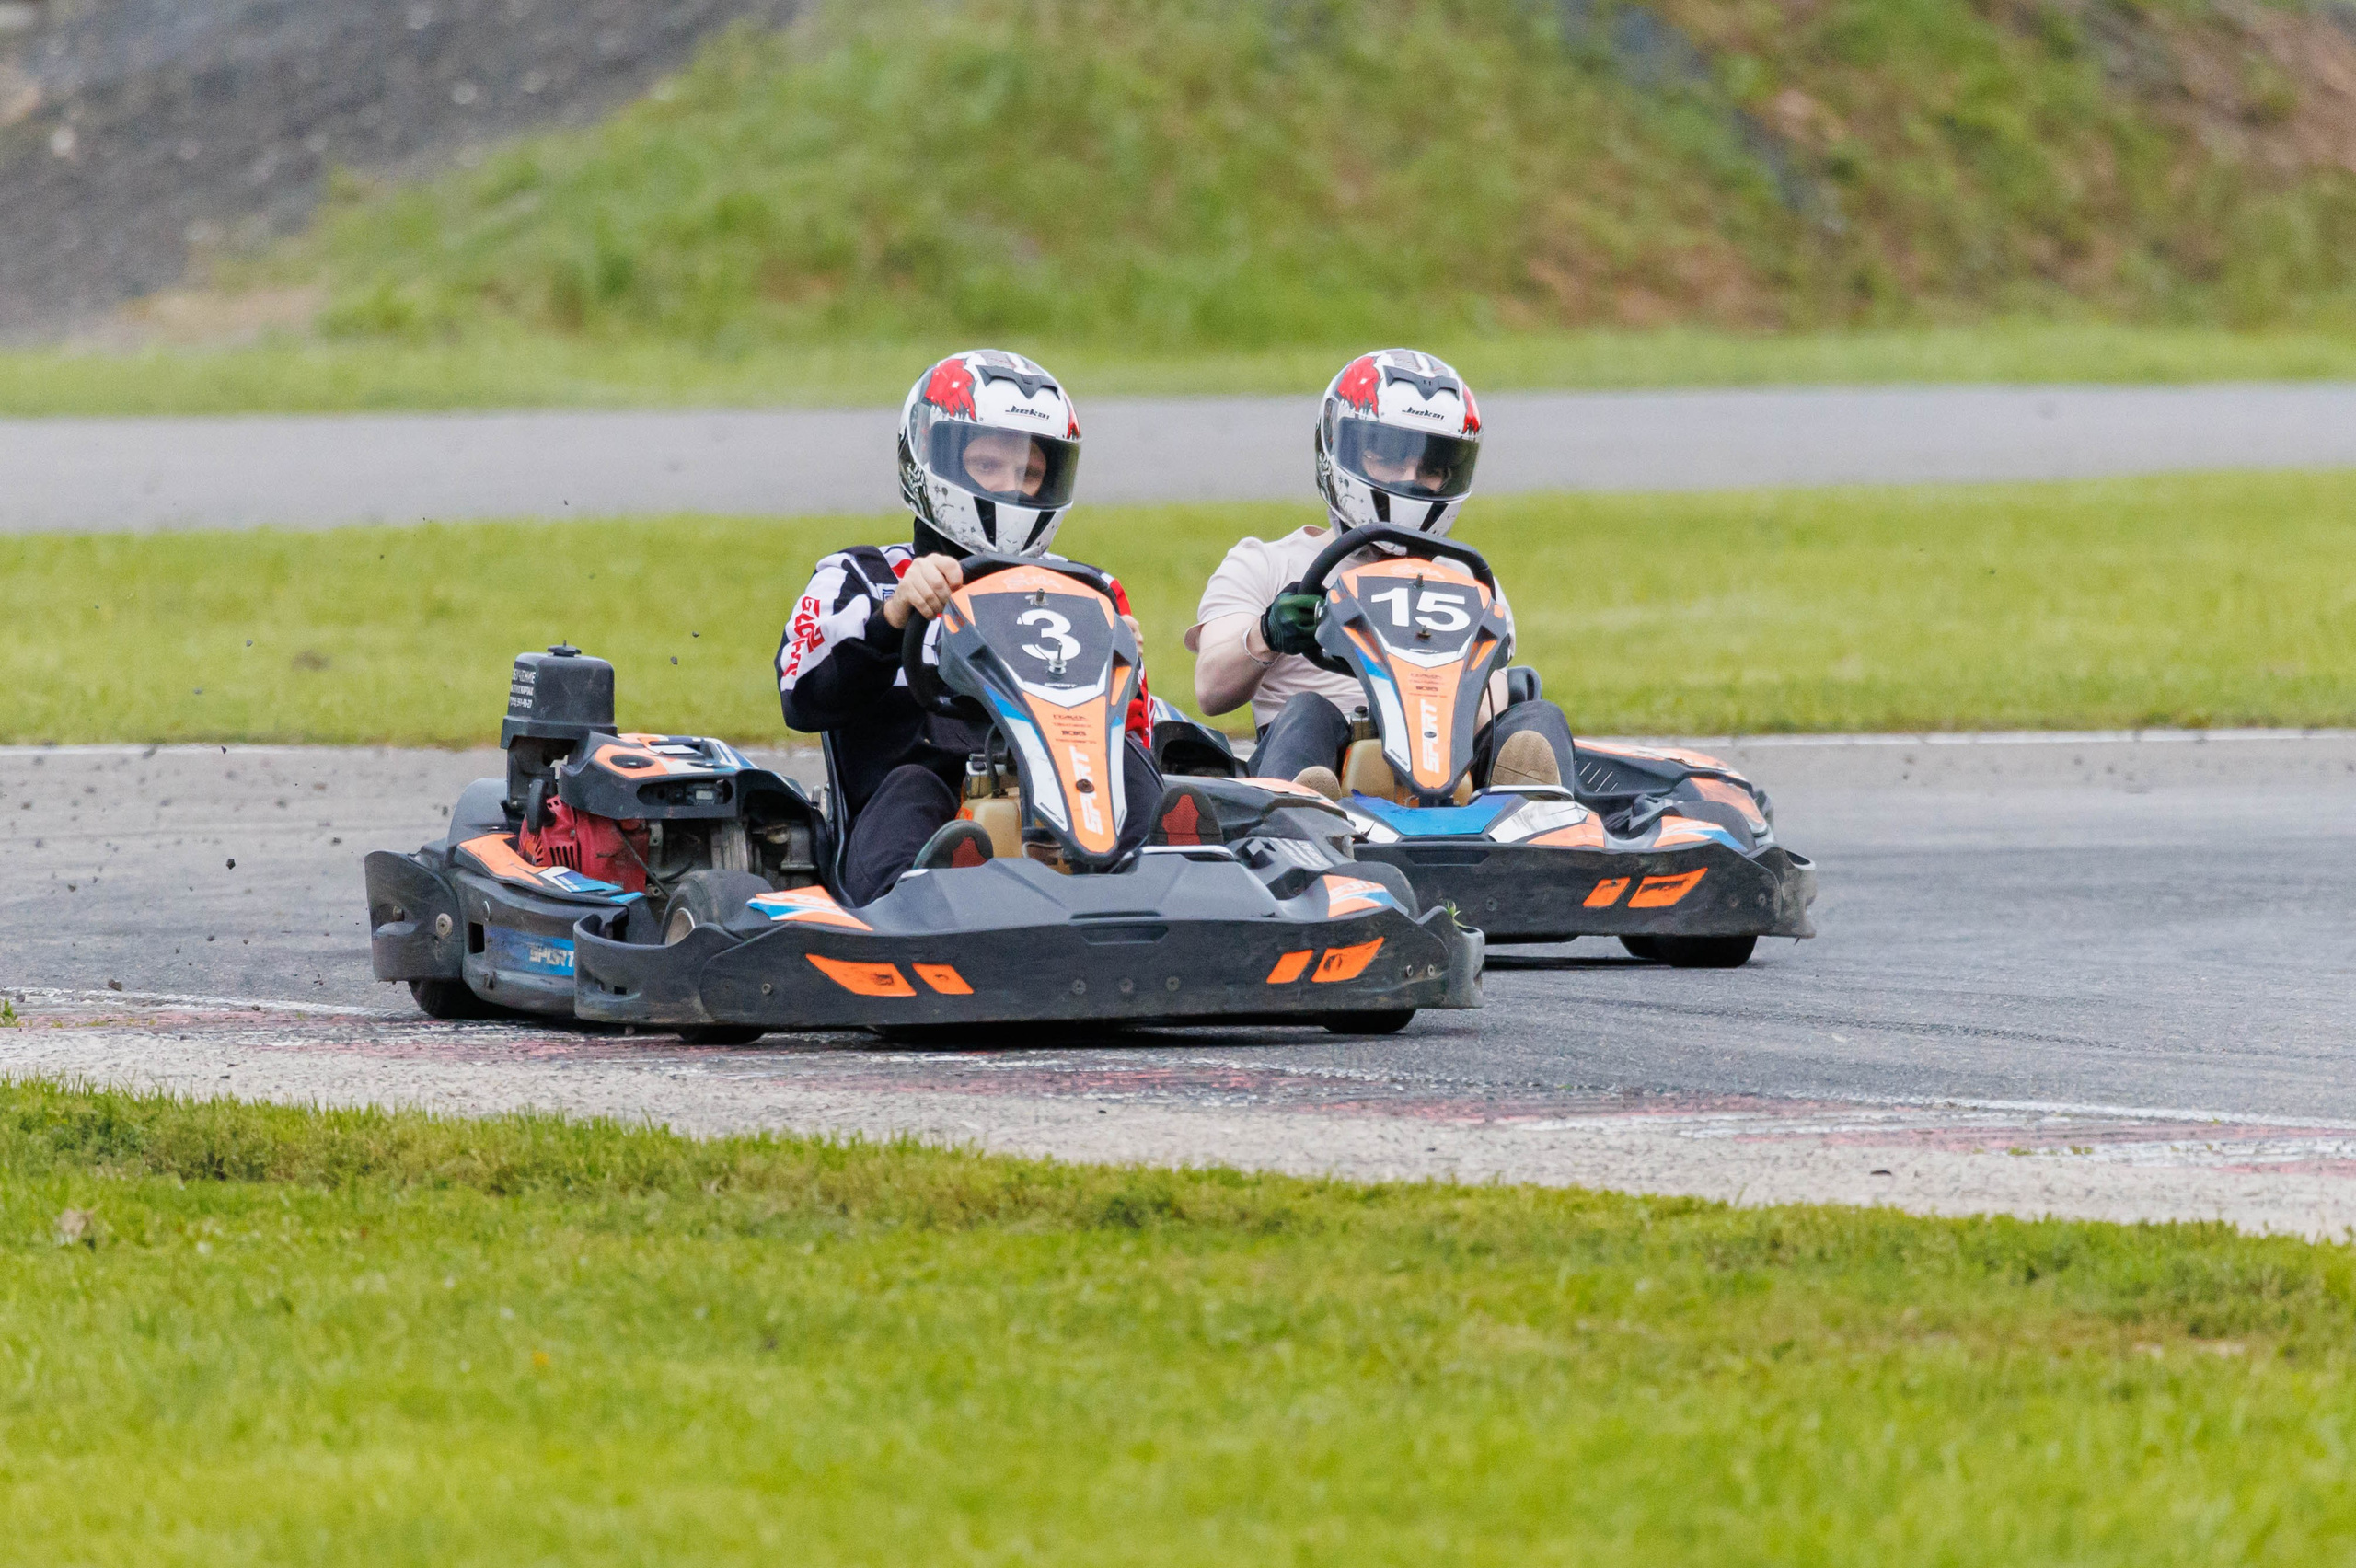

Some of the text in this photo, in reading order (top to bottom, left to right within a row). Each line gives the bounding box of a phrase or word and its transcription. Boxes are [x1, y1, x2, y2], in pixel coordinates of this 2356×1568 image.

[1016, 608, 1081, 661] 3
[1370, 587, 1471, 632] 15
[1420, 698, 1440, 773] SPORT
[1068, 745, 1103, 836] SPRT
